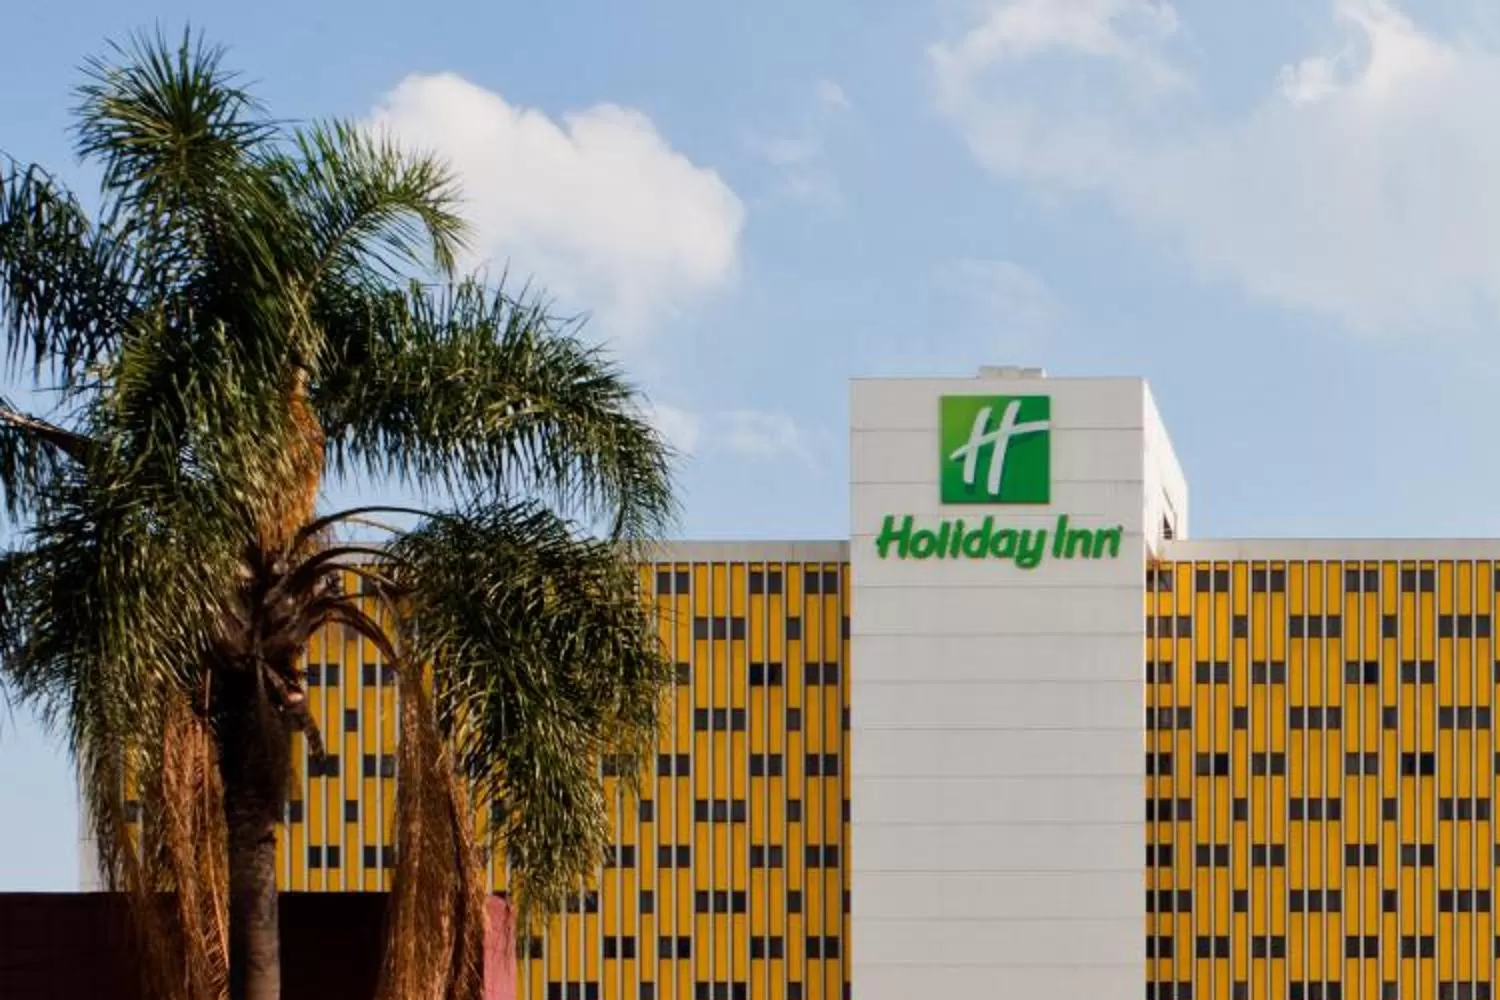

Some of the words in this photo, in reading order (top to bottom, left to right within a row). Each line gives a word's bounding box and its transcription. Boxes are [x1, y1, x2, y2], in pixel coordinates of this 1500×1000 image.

[949, 399, 1050, 495] H
[874, 513, 1049, 568] Holiday
[1051, 512, 1121, 559] Inn
